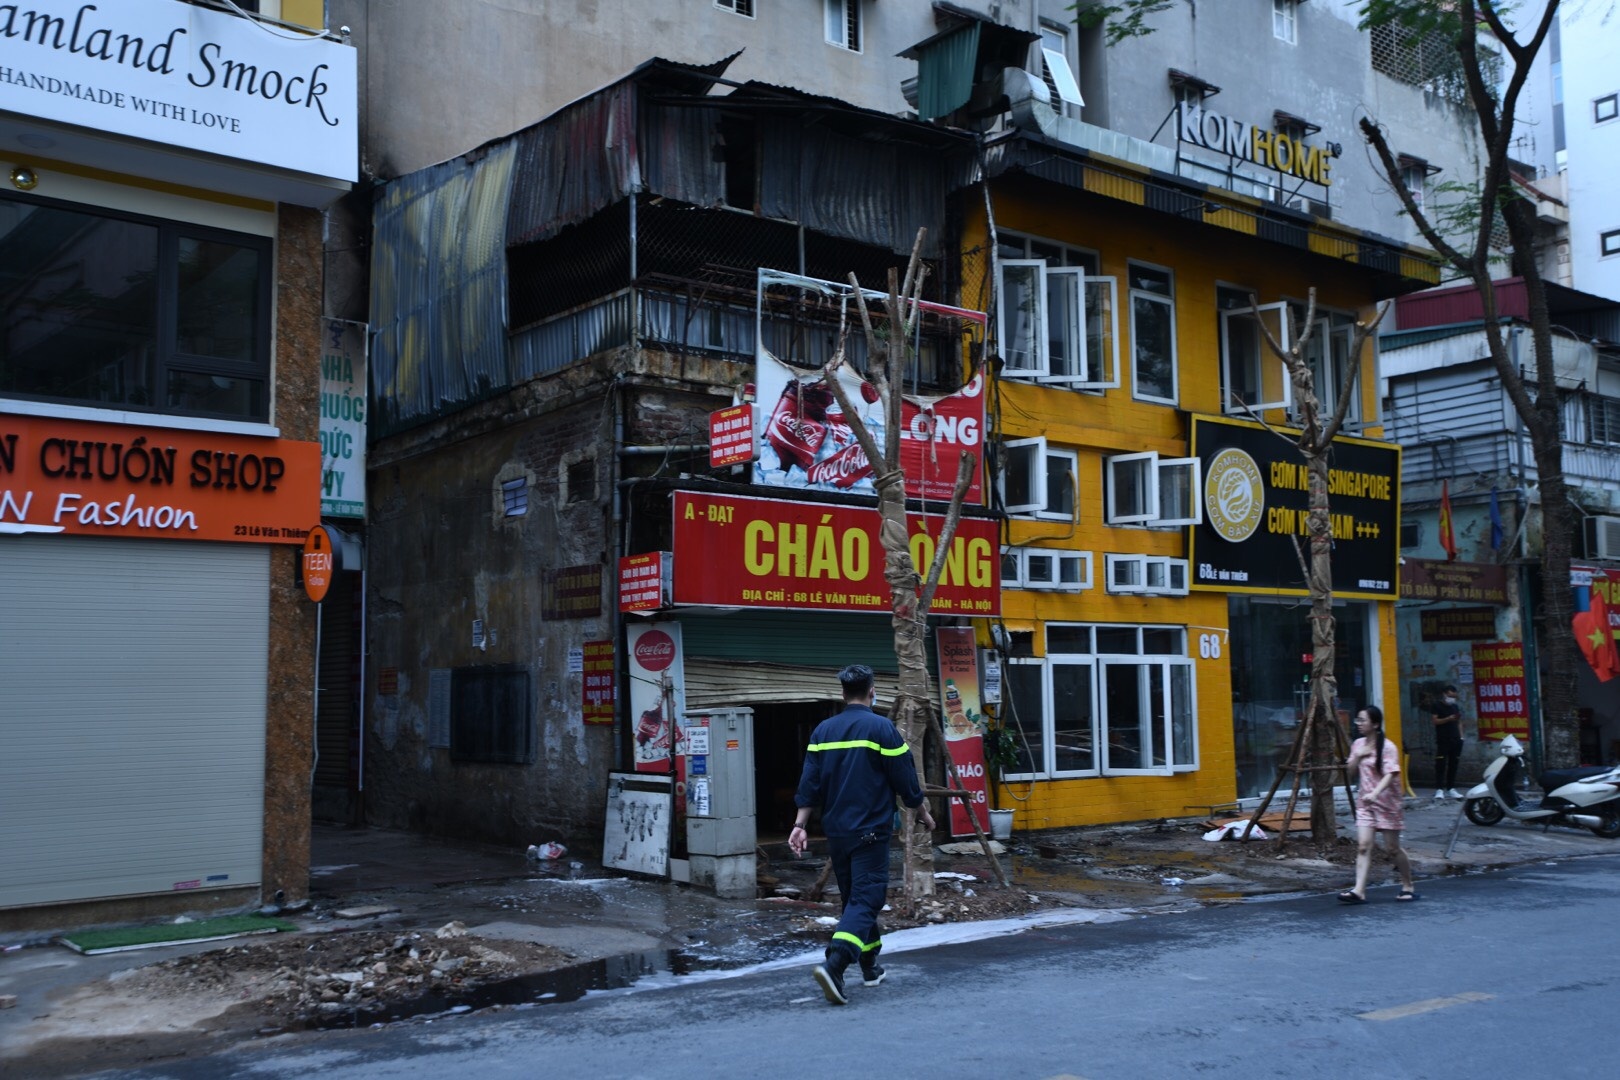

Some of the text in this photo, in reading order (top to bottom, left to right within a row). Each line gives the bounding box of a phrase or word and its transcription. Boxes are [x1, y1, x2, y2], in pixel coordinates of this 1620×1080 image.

[187, 42, 339, 127] Smock
[130, 95, 187, 122] WITH
[191, 109, 242, 134] LOVE
[1180, 101, 1332, 186] KOMHOME
[320, 387, 364, 423] HUỐC
[40, 436, 178, 485] CHUỐN
[190, 449, 285, 492] SHOP
[1212, 455, 1259, 487] KOMHOME
[1270, 460, 1296, 490] CƠM
[1328, 467, 1391, 501] SINGAPORE
[684, 501, 735, 527] A ĐẠT
[1267, 506, 1296, 535] CƠM
[234, 525, 248, 536] 23
[743, 513, 870, 582] CHÁO
[907, 519, 993, 588] ÒNG
[303, 552, 333, 571] TEEN
[1198, 563, 1212, 579] 68
[742, 589, 763, 602] ĐỊA
[765, 588, 785, 602] CHỈ
[793, 591, 807, 603] 68
[810, 590, 823, 603] LÊ
[849, 592, 881, 606] THIÊM
[960, 597, 973, 610] HÀ
[975, 597, 992, 611] NỘI
[943, 645, 974, 659] Splash
[1199, 633, 1221, 659] 68
[1478, 680, 1522, 697] BÚN BÒ
[1480, 698, 1523, 715] NAM BỘ
